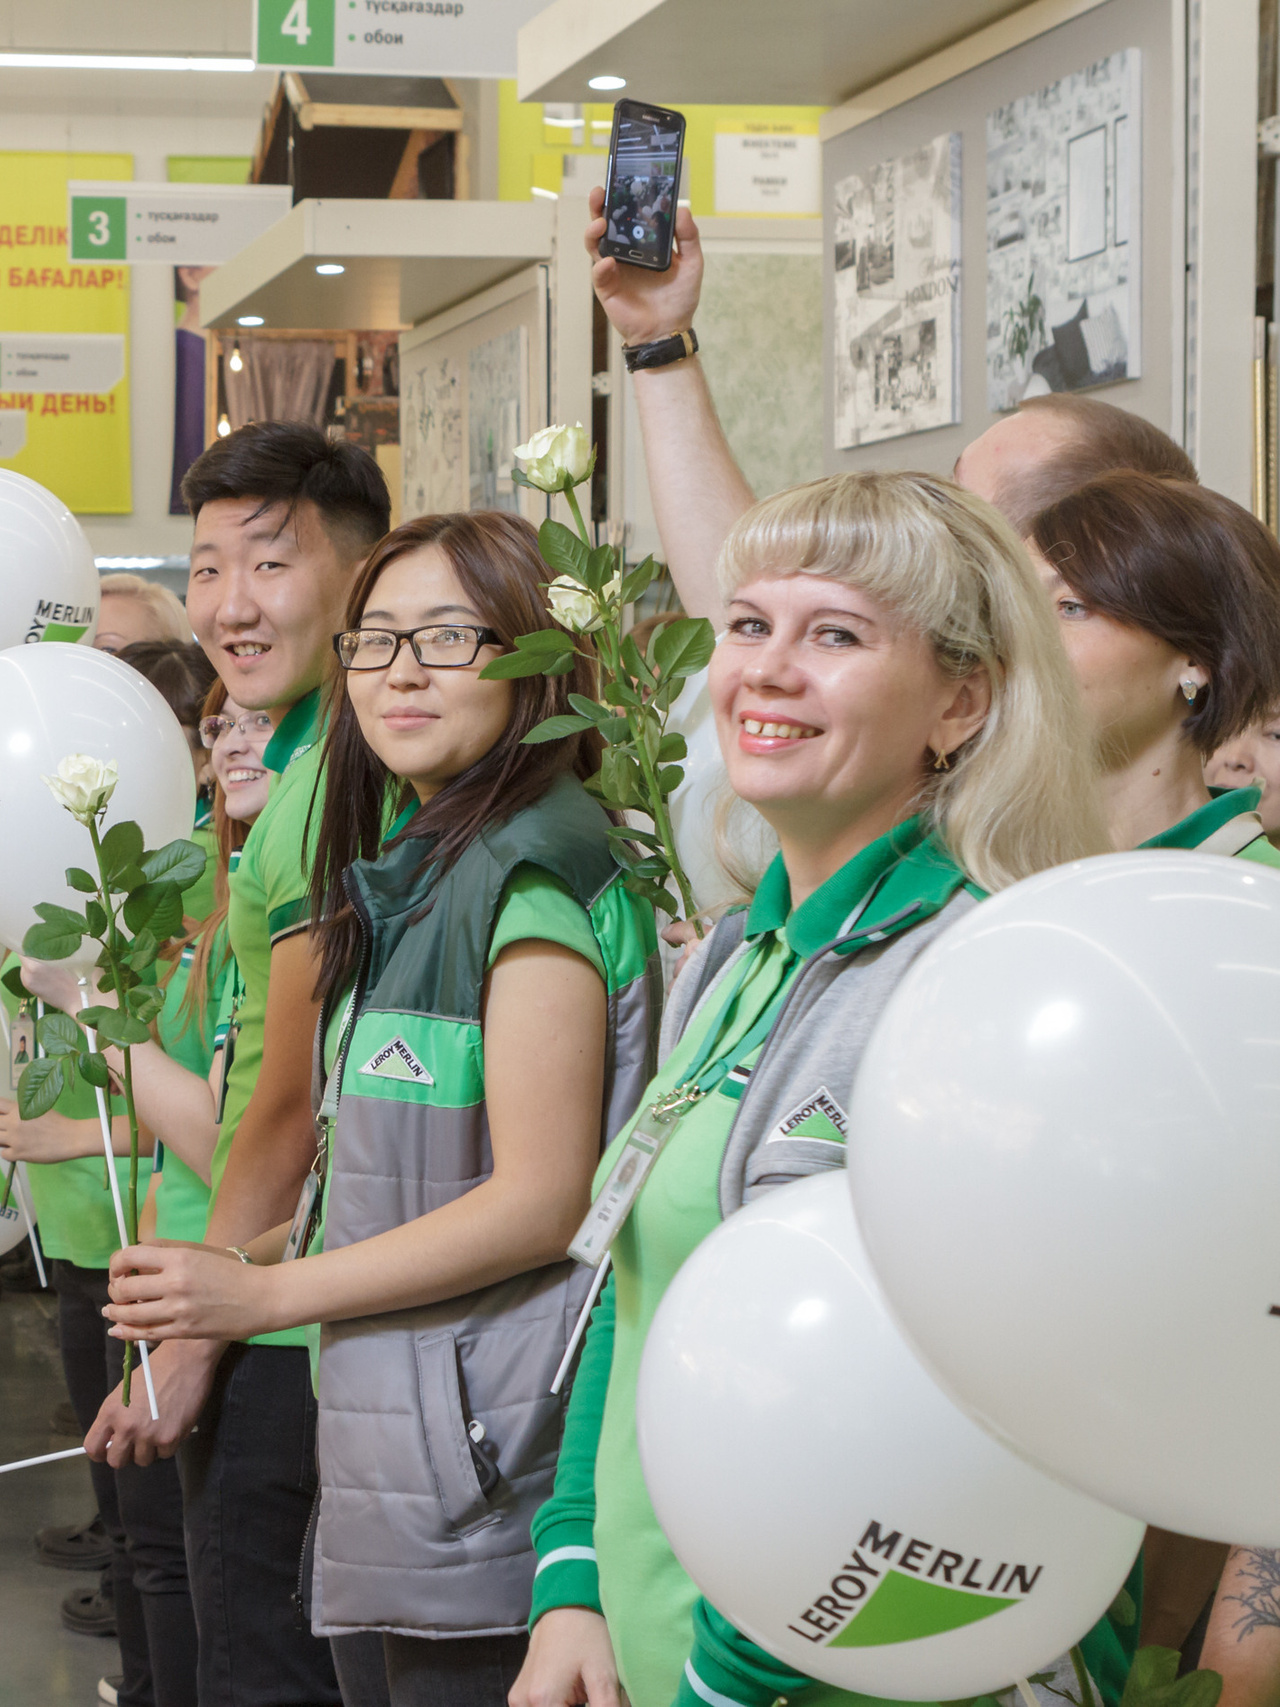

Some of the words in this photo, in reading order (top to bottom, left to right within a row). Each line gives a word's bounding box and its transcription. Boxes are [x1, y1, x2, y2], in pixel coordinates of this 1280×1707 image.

[281, 0, 312, 45] 4
[364, 29, 404, 44] обои
[88, 211, 111, 246] 3
[147, 232, 176, 243] обои
[8, 268, 123, 289] БАҒАЛАР!
[40, 394, 116, 416] ДЕНЬ!
[36, 600, 95, 623] MERLIN
[370, 1045, 395, 1070] LEROY
[393, 1040, 423, 1077] MERLIN
[779, 1101, 819, 1135] LEROY
[816, 1095, 848, 1138] MERL
[787, 1549, 880, 1643] LEROY
[858, 1520, 1044, 1594] MERLIN
